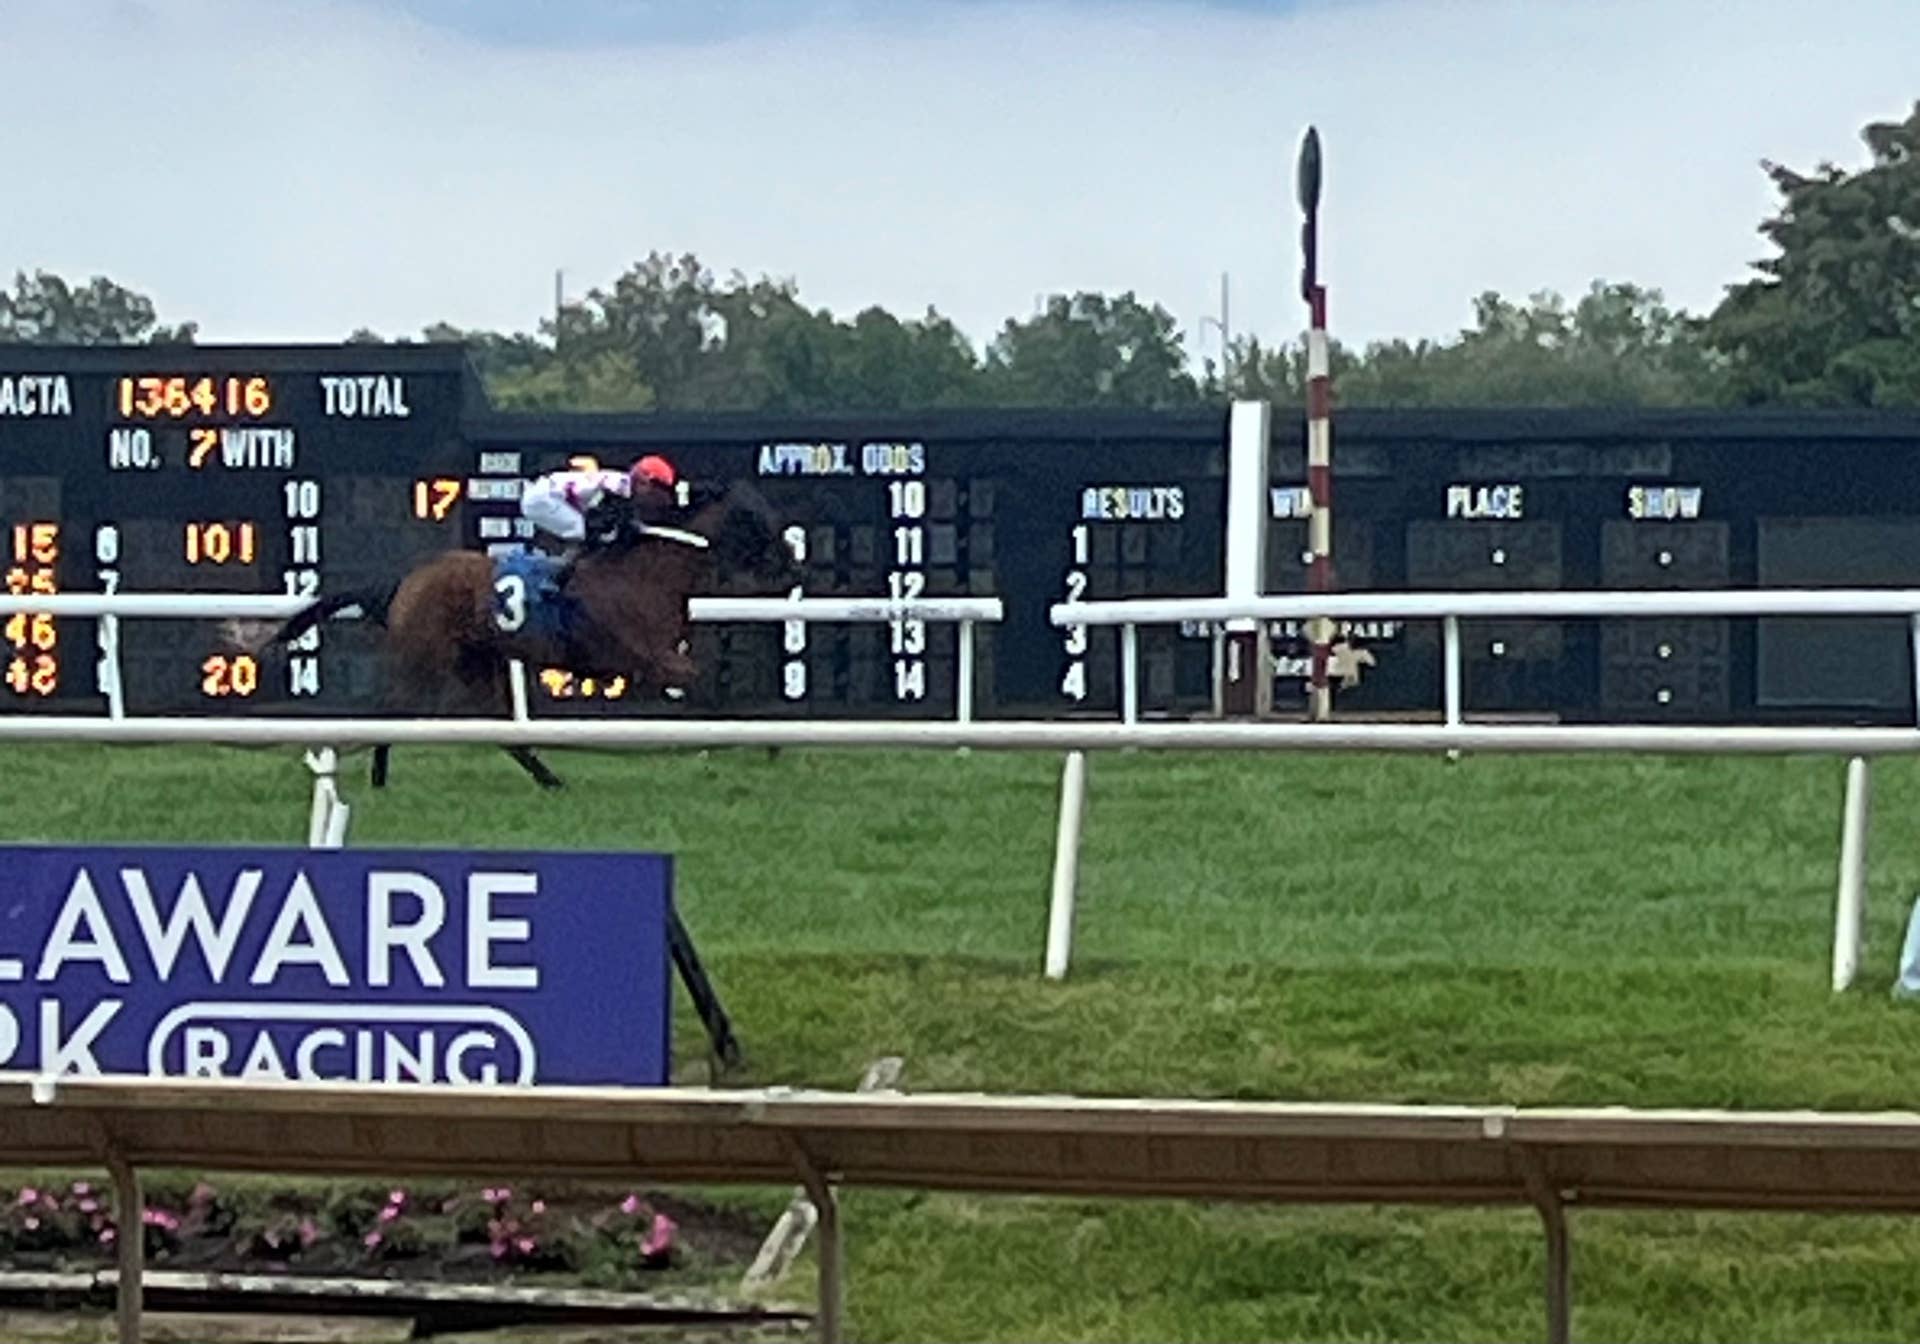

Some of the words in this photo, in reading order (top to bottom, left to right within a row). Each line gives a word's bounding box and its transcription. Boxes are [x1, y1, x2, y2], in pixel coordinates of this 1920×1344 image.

[0, 376, 71, 415] ACTA
[321, 376, 409, 415] TOTAL
[110, 430, 161, 468] NO.
[189, 430, 217, 467] 7
[222, 430, 294, 467] WITH
[758, 444, 854, 475] APPROX.
[862, 444, 925, 475] ODDS
[285, 481, 318, 518] 10
[415, 480, 460, 519] 17
[889, 481, 925, 518] 10
[1082, 487, 1184, 518] RESULTS
[1447, 486, 1522, 517] PLACE
[1628, 487, 1701, 518] SHOW
[14, 524, 58, 563] 15
[186, 523, 253, 563] 101
[291, 526, 318, 563] 11
[895, 526, 922, 563] 11
[1072, 525, 1087, 563] 1
[495, 575, 525, 631] 3
[889, 572, 925, 600] 12
[1066, 572, 1087, 602] 2
[889, 617, 925, 653] 13
[202, 656, 257, 696] 20
[290, 658, 319, 695] 14
[895, 659, 924, 698] 14
[1063, 662, 1086, 700] 4
[184, 1026, 498, 1084] RACING
